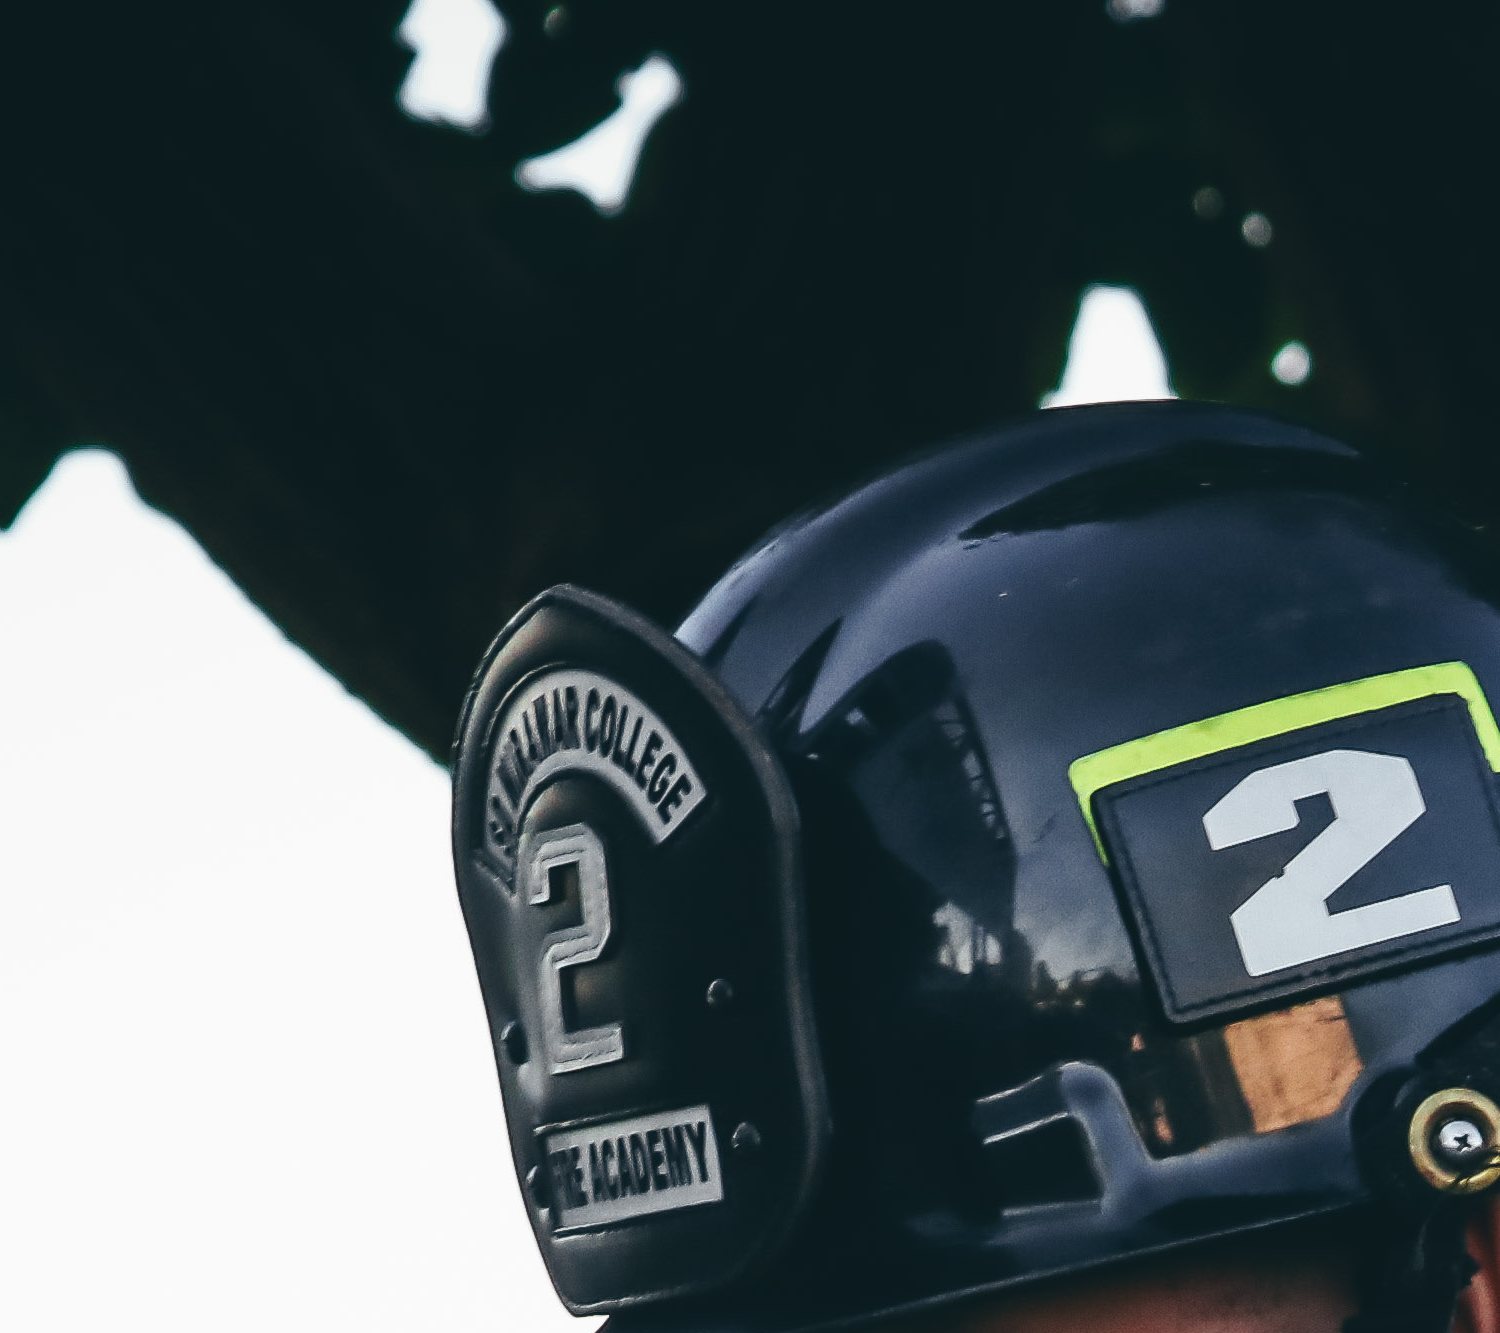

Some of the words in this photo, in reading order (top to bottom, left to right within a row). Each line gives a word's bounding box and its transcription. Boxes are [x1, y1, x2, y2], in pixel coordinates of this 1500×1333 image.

[585, 686, 692, 825] COLLEGE
[522, 822, 624, 1075] 2
[1202, 749, 1461, 976] 2
[589, 1121, 709, 1203] ACADEMY
